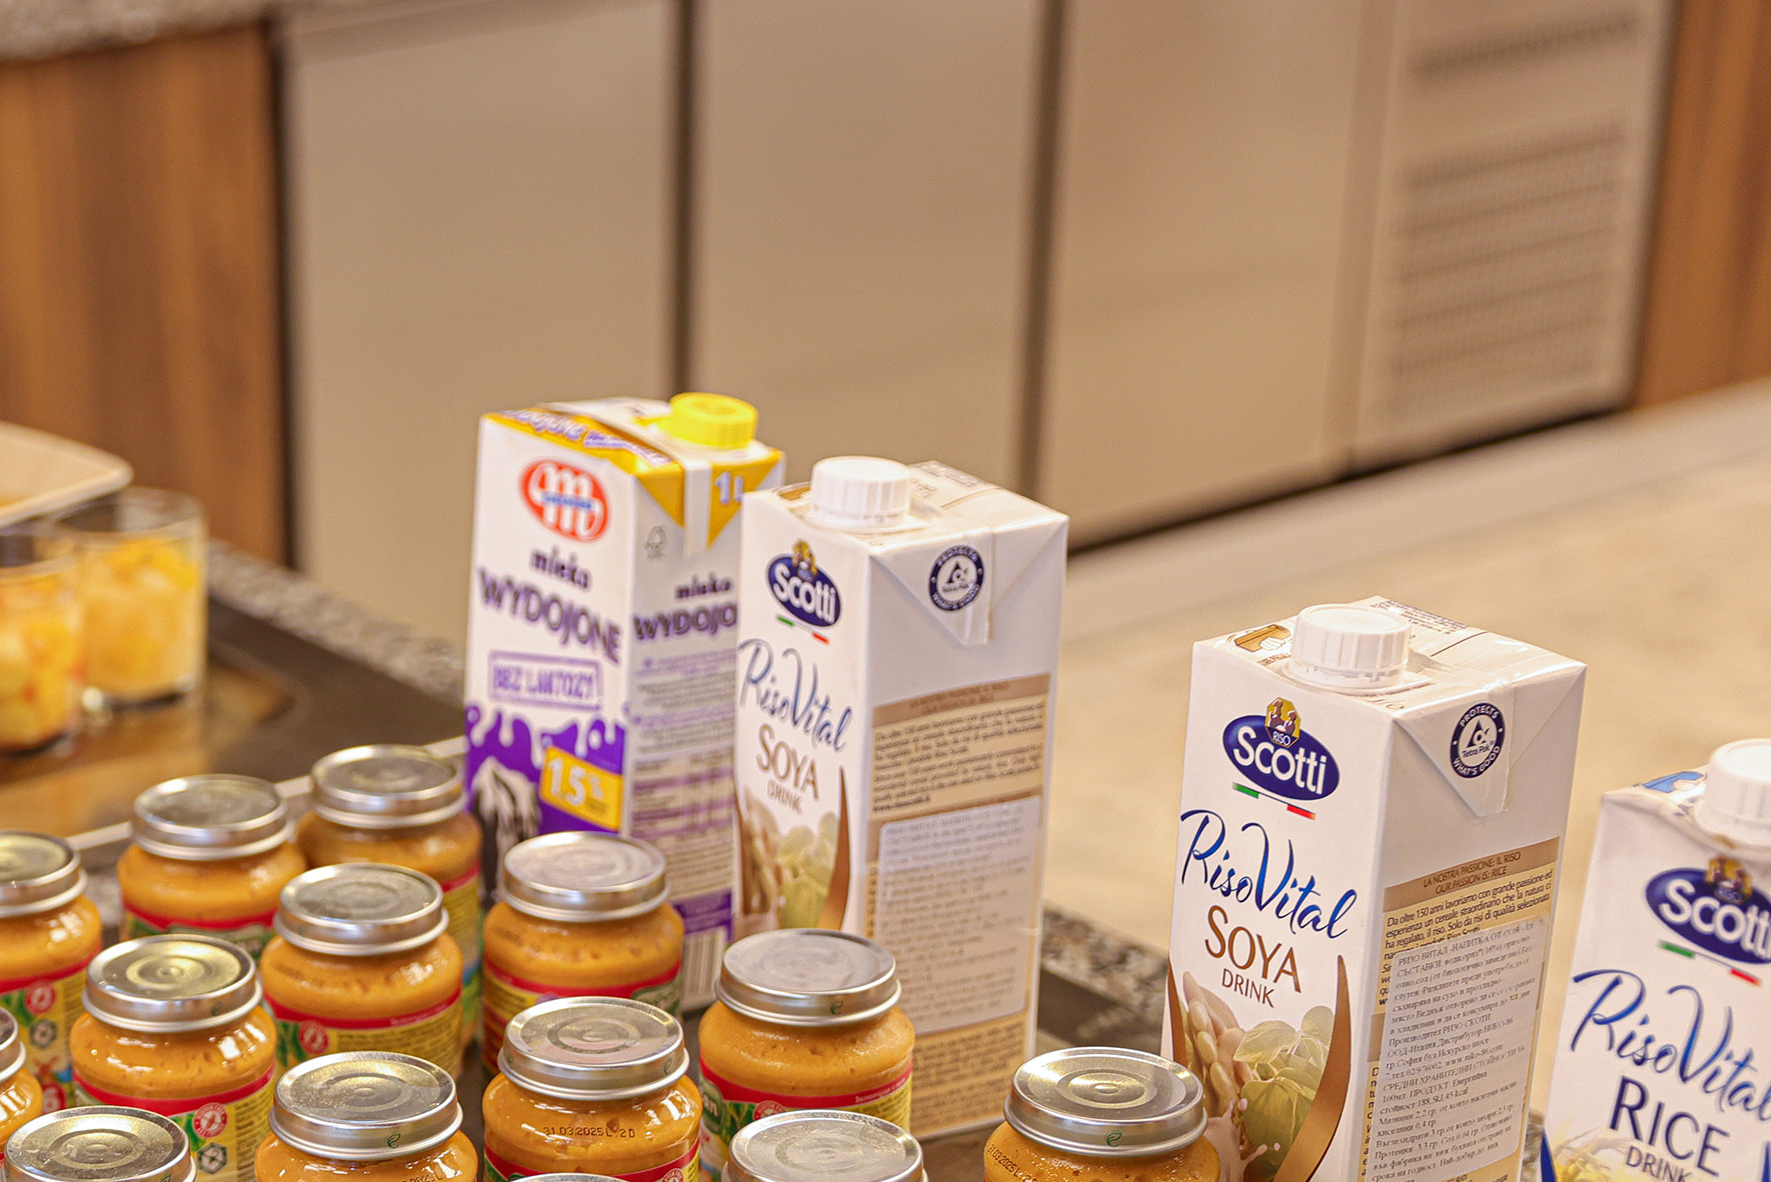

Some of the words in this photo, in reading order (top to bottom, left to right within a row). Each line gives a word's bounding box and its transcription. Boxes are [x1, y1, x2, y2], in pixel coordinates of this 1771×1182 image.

[479, 567, 621, 665] WYDOJONE
[773, 562, 836, 624] Scotti
[634, 602, 738, 641] WYDOJO
[738, 638, 853, 752] RisoVital
[1459, 704, 1500, 727] PROTECTS
[1233, 725, 1327, 795] Scotti
[1272, 730, 1291, 746] RISO
[1453, 757, 1478, 776] WHAT'S
[1479, 745, 1500, 772] GOOD
[756, 723, 819, 801] SOYA
[767, 779, 804, 814] DRINK
[1180, 809, 1357, 939] RisoVital
[1432, 868, 1460, 884] NOSTRA
[1503, 850, 1521, 863] RISO
[1435, 881, 1450, 894] OUR
[1450, 873, 1480, 889] PASSION
[1492, 865, 1507, 877] RICE
[1385, 920, 1423, 940] esperienza
[1434, 908, 1458, 923] cereale
[1502, 891, 1515, 903] che
[1524, 884, 1544, 896] natura
[1387, 915, 1398, 927] Da
[1399, 910, 1415, 923] oltre
[1416, 906, 1428, 918] 150
[1429, 901, 1444, 914] anni
[1444, 891, 1477, 909] lavoriamo
[1478, 889, 1490, 899] con
[1491, 879, 1515, 898] grande
[1515, 872, 1544, 893] passione
[1659, 879, 1771, 959] Scott
[1204, 905, 1302, 993] SOYA
[1384, 937, 1395, 949] ha
[1447, 918, 1463, 931] Solo
[1463, 914, 1472, 926] da
[1221, 968, 1275, 1008] DRINK
[543, 1126, 604, 1137] 31.03.2025
[1610, 1075, 1730, 1177] RICE
[987, 1145, 1017, 1178] 31.03.2025
